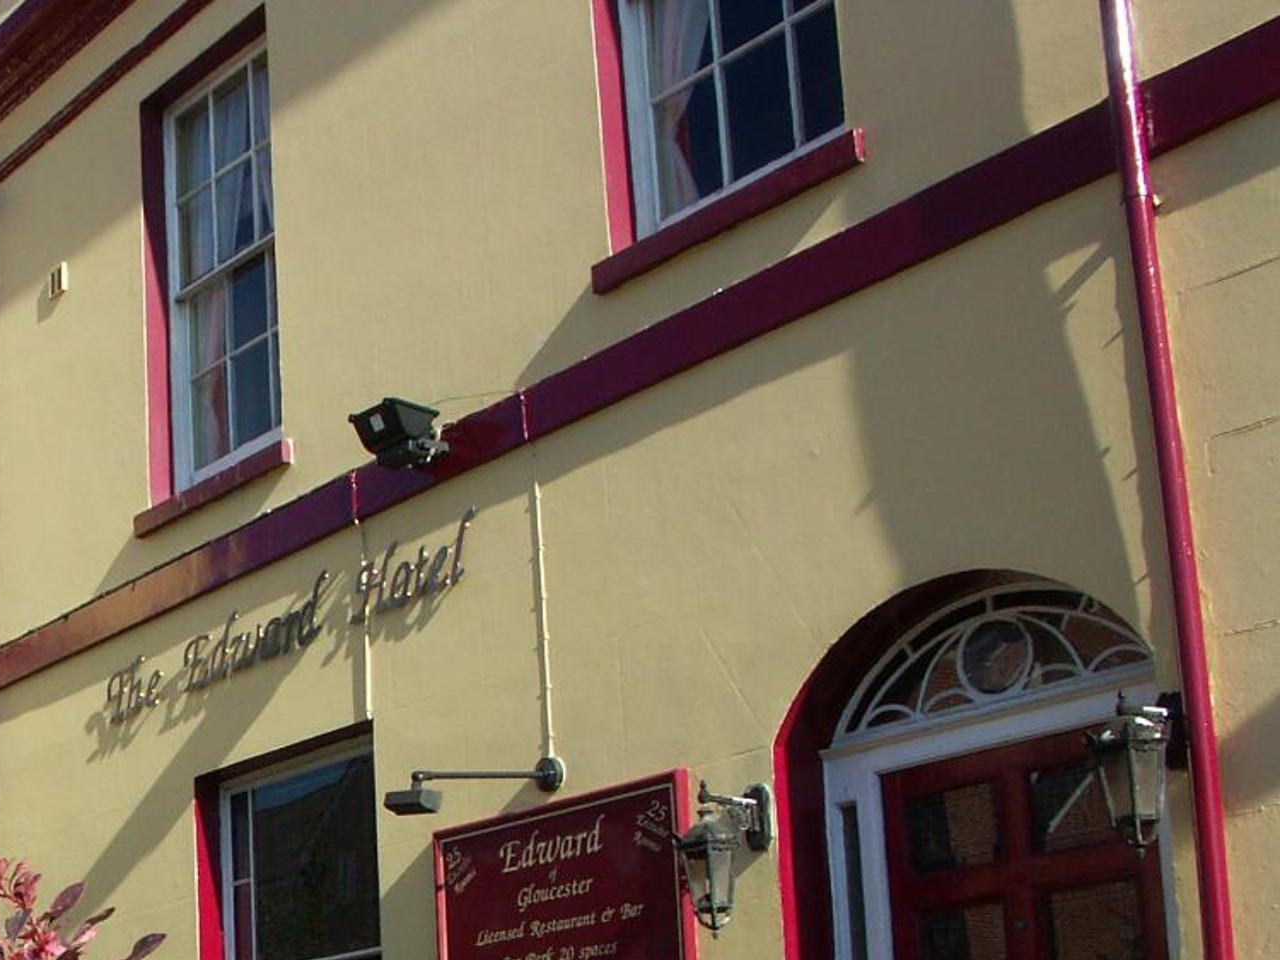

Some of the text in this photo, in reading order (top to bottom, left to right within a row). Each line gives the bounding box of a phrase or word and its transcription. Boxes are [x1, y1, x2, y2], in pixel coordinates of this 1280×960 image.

[106, 505, 477, 726] The Edward Hotel
[499, 814, 605, 874] Edward
[517, 877, 593, 912] Gloucester
[475, 903, 643, 947] Licensed Restaurant & Bar
